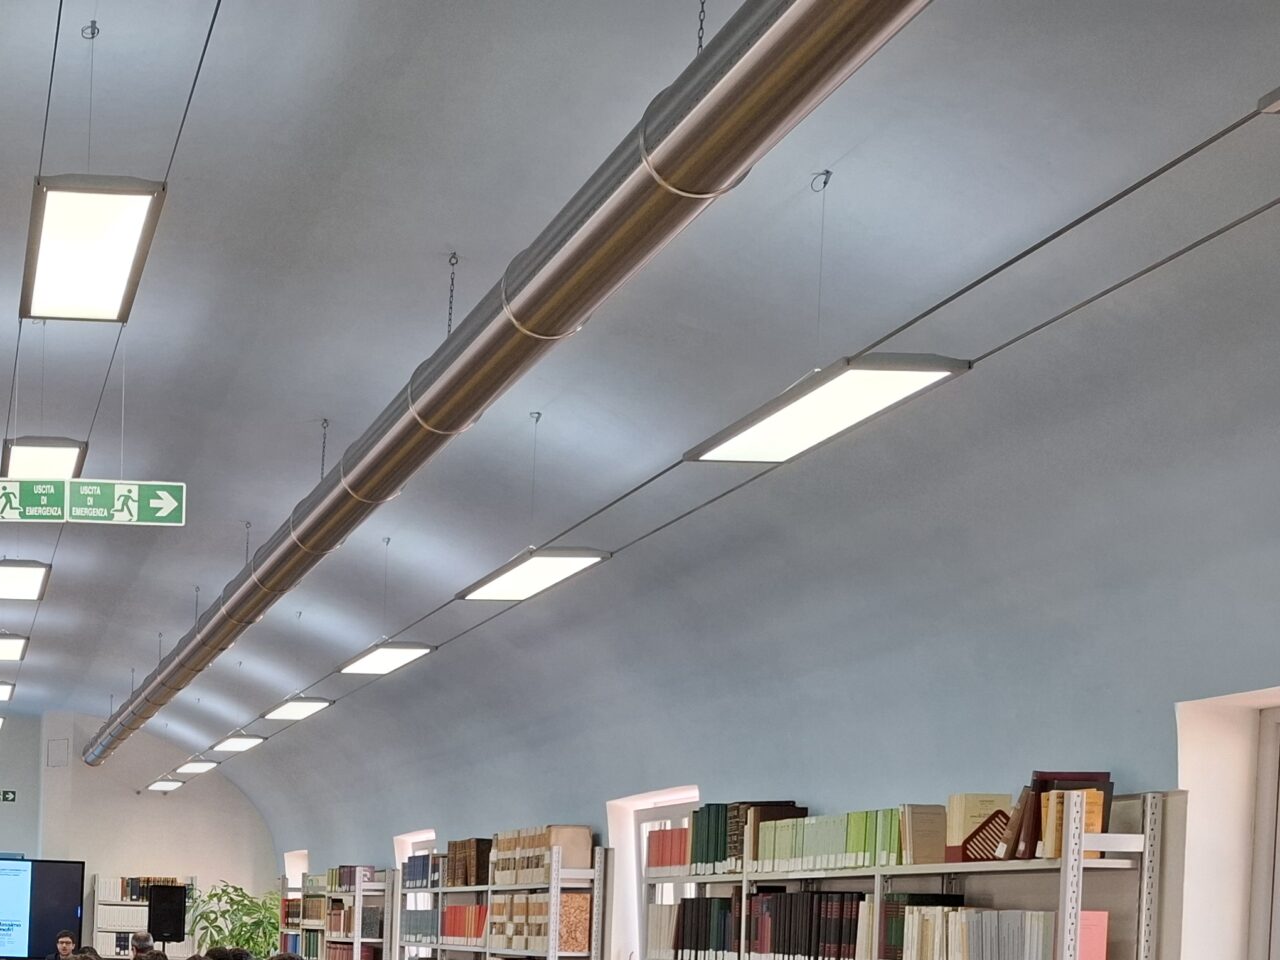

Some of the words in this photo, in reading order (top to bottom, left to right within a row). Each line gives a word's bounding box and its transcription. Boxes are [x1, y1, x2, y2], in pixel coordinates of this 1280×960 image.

[34, 485, 55, 494] USCITA
[80, 485, 101, 495] USCITA
[40, 496, 47, 505] DI
[87, 497, 93, 505] DI
[26, 507, 62, 516] EMERGENZA
[72, 507, 108, 517] EMERGENZA
